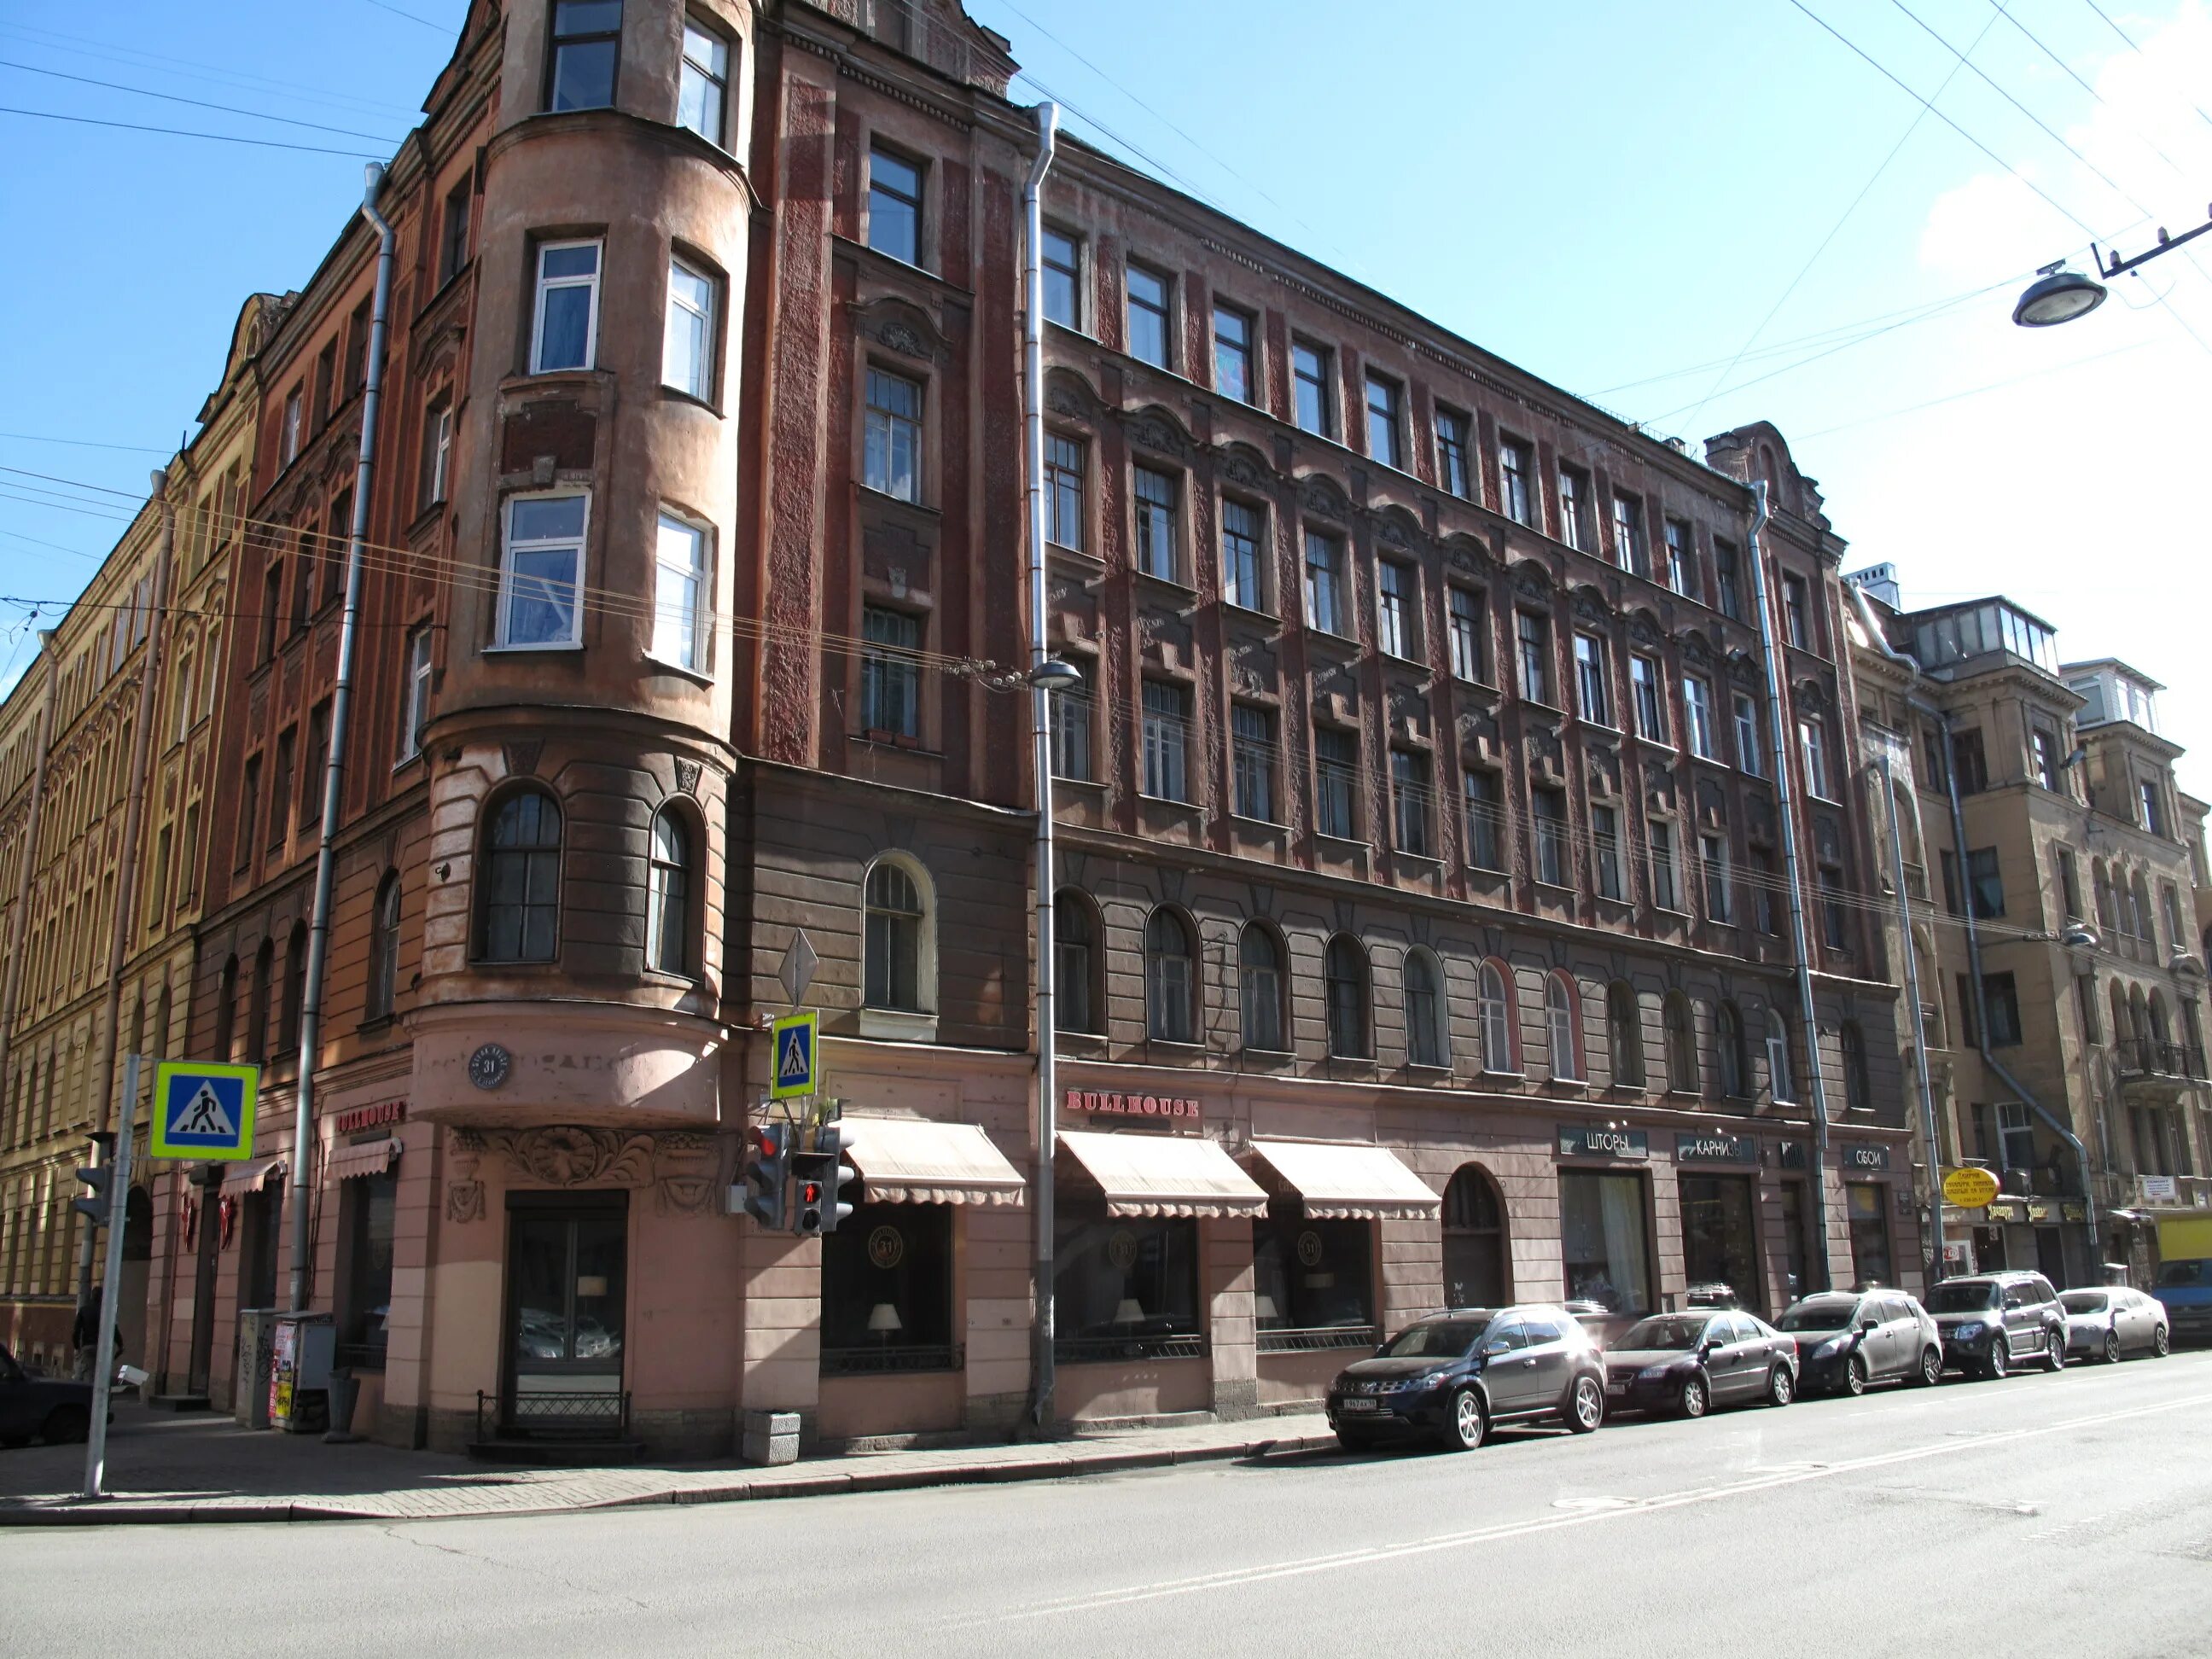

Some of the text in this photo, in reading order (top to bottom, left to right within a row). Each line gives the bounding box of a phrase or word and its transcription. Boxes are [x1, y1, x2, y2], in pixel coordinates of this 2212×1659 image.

[484, 1060, 495, 1073] 31
[1067, 1091, 1199, 1116] BULLHOUSE
[1586, 1132, 1629, 1151] ШТОРЫ
[1696, 1139, 1742, 1157] КАРНИЗЫ
[1855, 1150, 1881, 1166] ОБОИ
